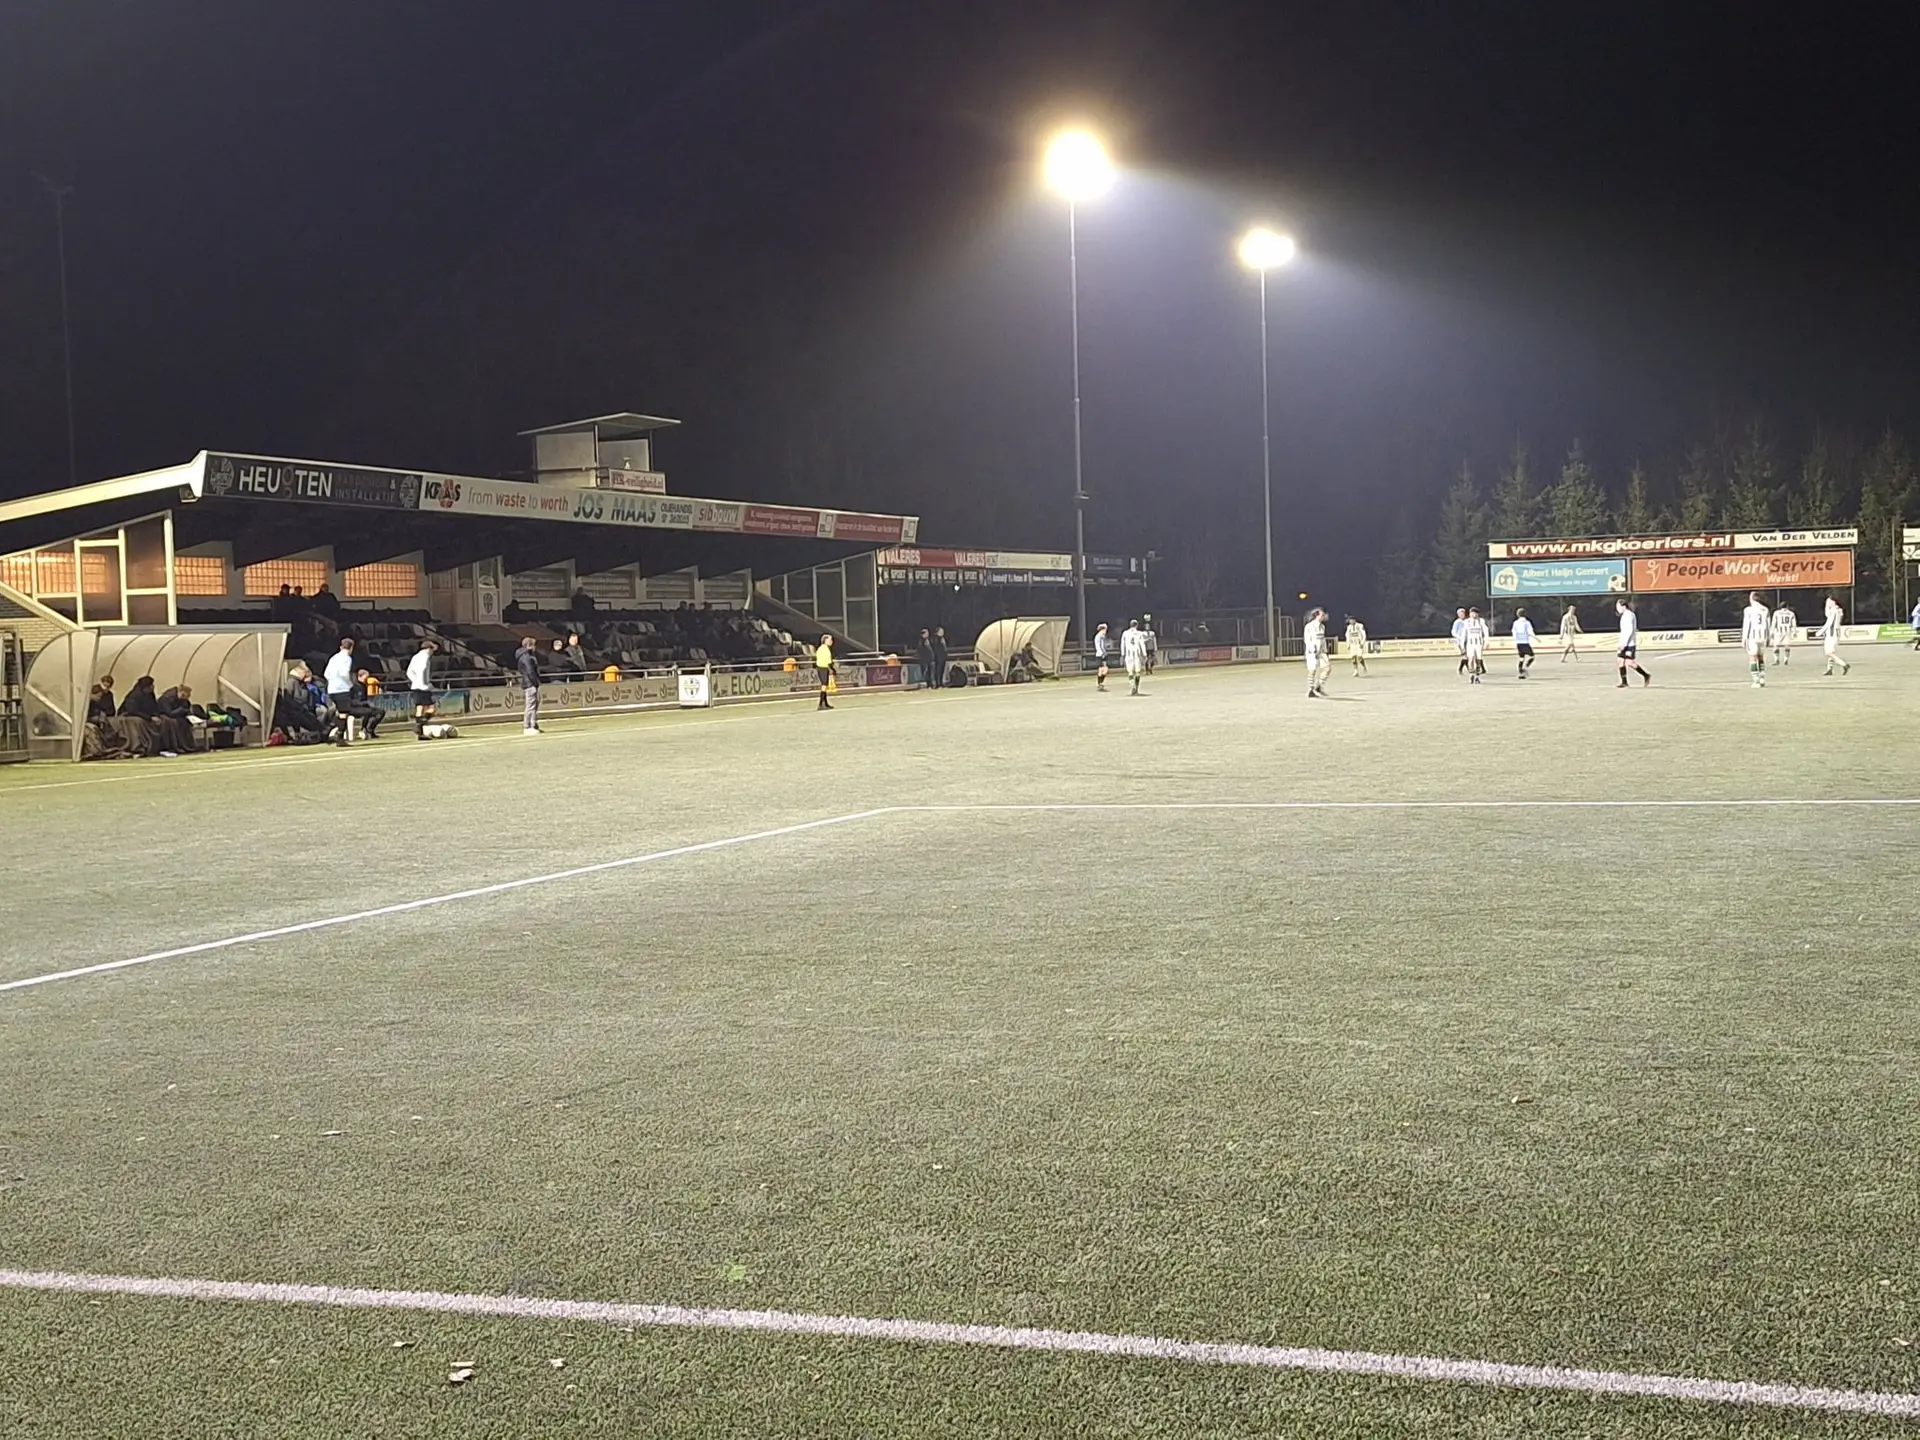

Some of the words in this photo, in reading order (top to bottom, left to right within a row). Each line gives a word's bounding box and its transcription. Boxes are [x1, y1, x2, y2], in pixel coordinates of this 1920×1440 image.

[468, 487, 493, 505] from
[495, 491, 526, 508] waste
[528, 493, 538, 510] to
[540, 495, 569, 512] worth
[573, 493, 604, 519] JOS
[611, 496, 656, 523] MAAS
[1752, 534, 1778, 542] VAN
[1782, 532, 1806, 540] DER
[1812, 531, 1855, 540] VELDEN
[885, 549, 920, 565] VALERES
[954, 551, 985, 566] VALERES
[1522, 569, 1550, 578] Albert
[1666, 556, 1835, 579] PeopleWorkService
[1767, 573, 1799, 584] Werkt!
[1757, 614, 1763, 625] 3
[1130, 637, 1135, 646] 4
[731, 674, 762, 695] ELCO
